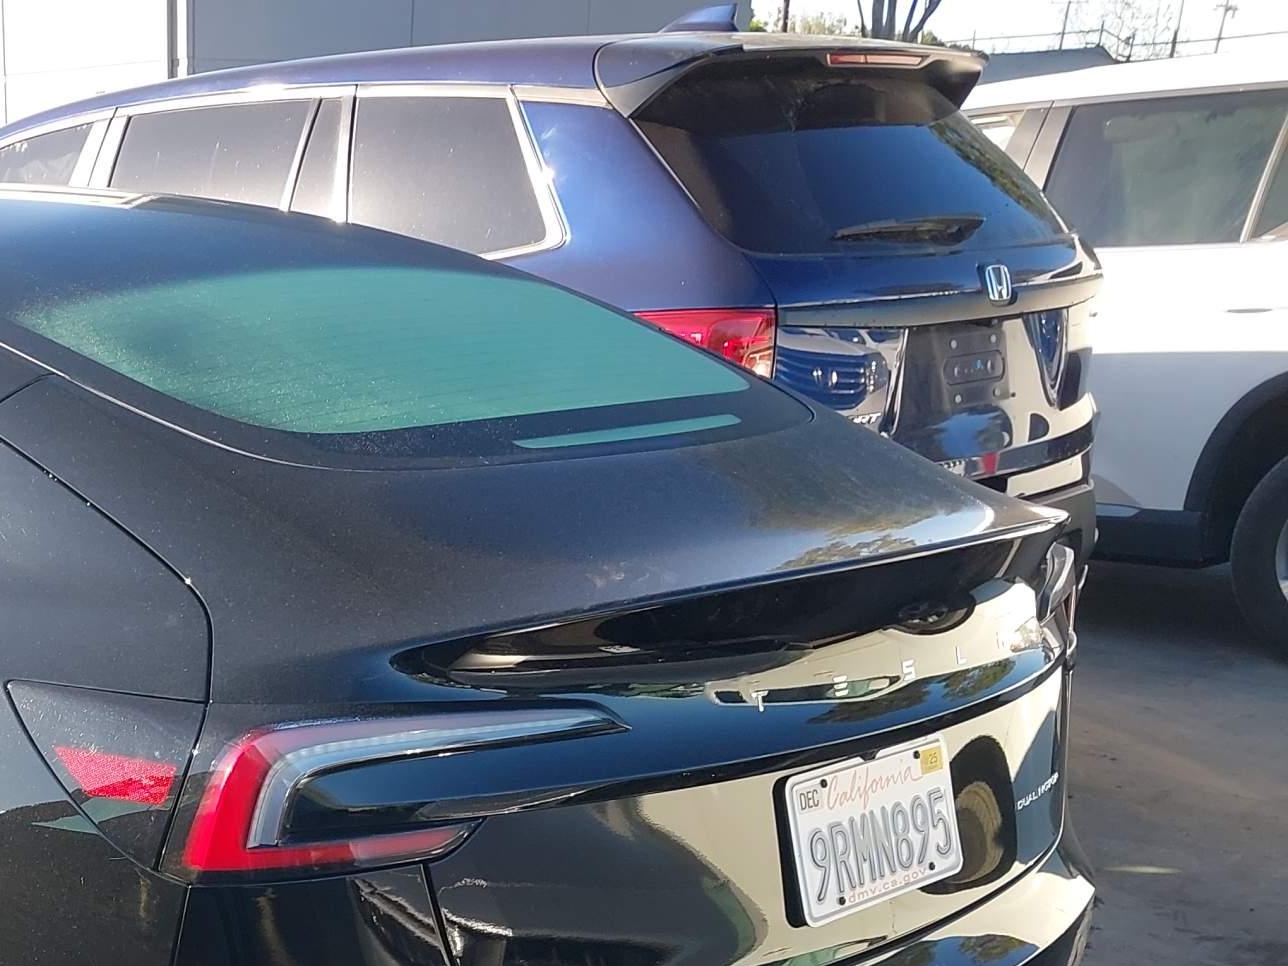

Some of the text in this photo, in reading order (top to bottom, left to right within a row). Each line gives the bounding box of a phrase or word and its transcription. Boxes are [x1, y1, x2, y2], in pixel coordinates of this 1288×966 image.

[751, 632, 1008, 713] TESL
[799, 789, 820, 811] DEC
[826, 758, 922, 810] California
[1017, 791, 1039, 811] DUAL
[809, 786, 954, 904] 9RMN895
[848, 866, 927, 905] dmv.ca.gov
